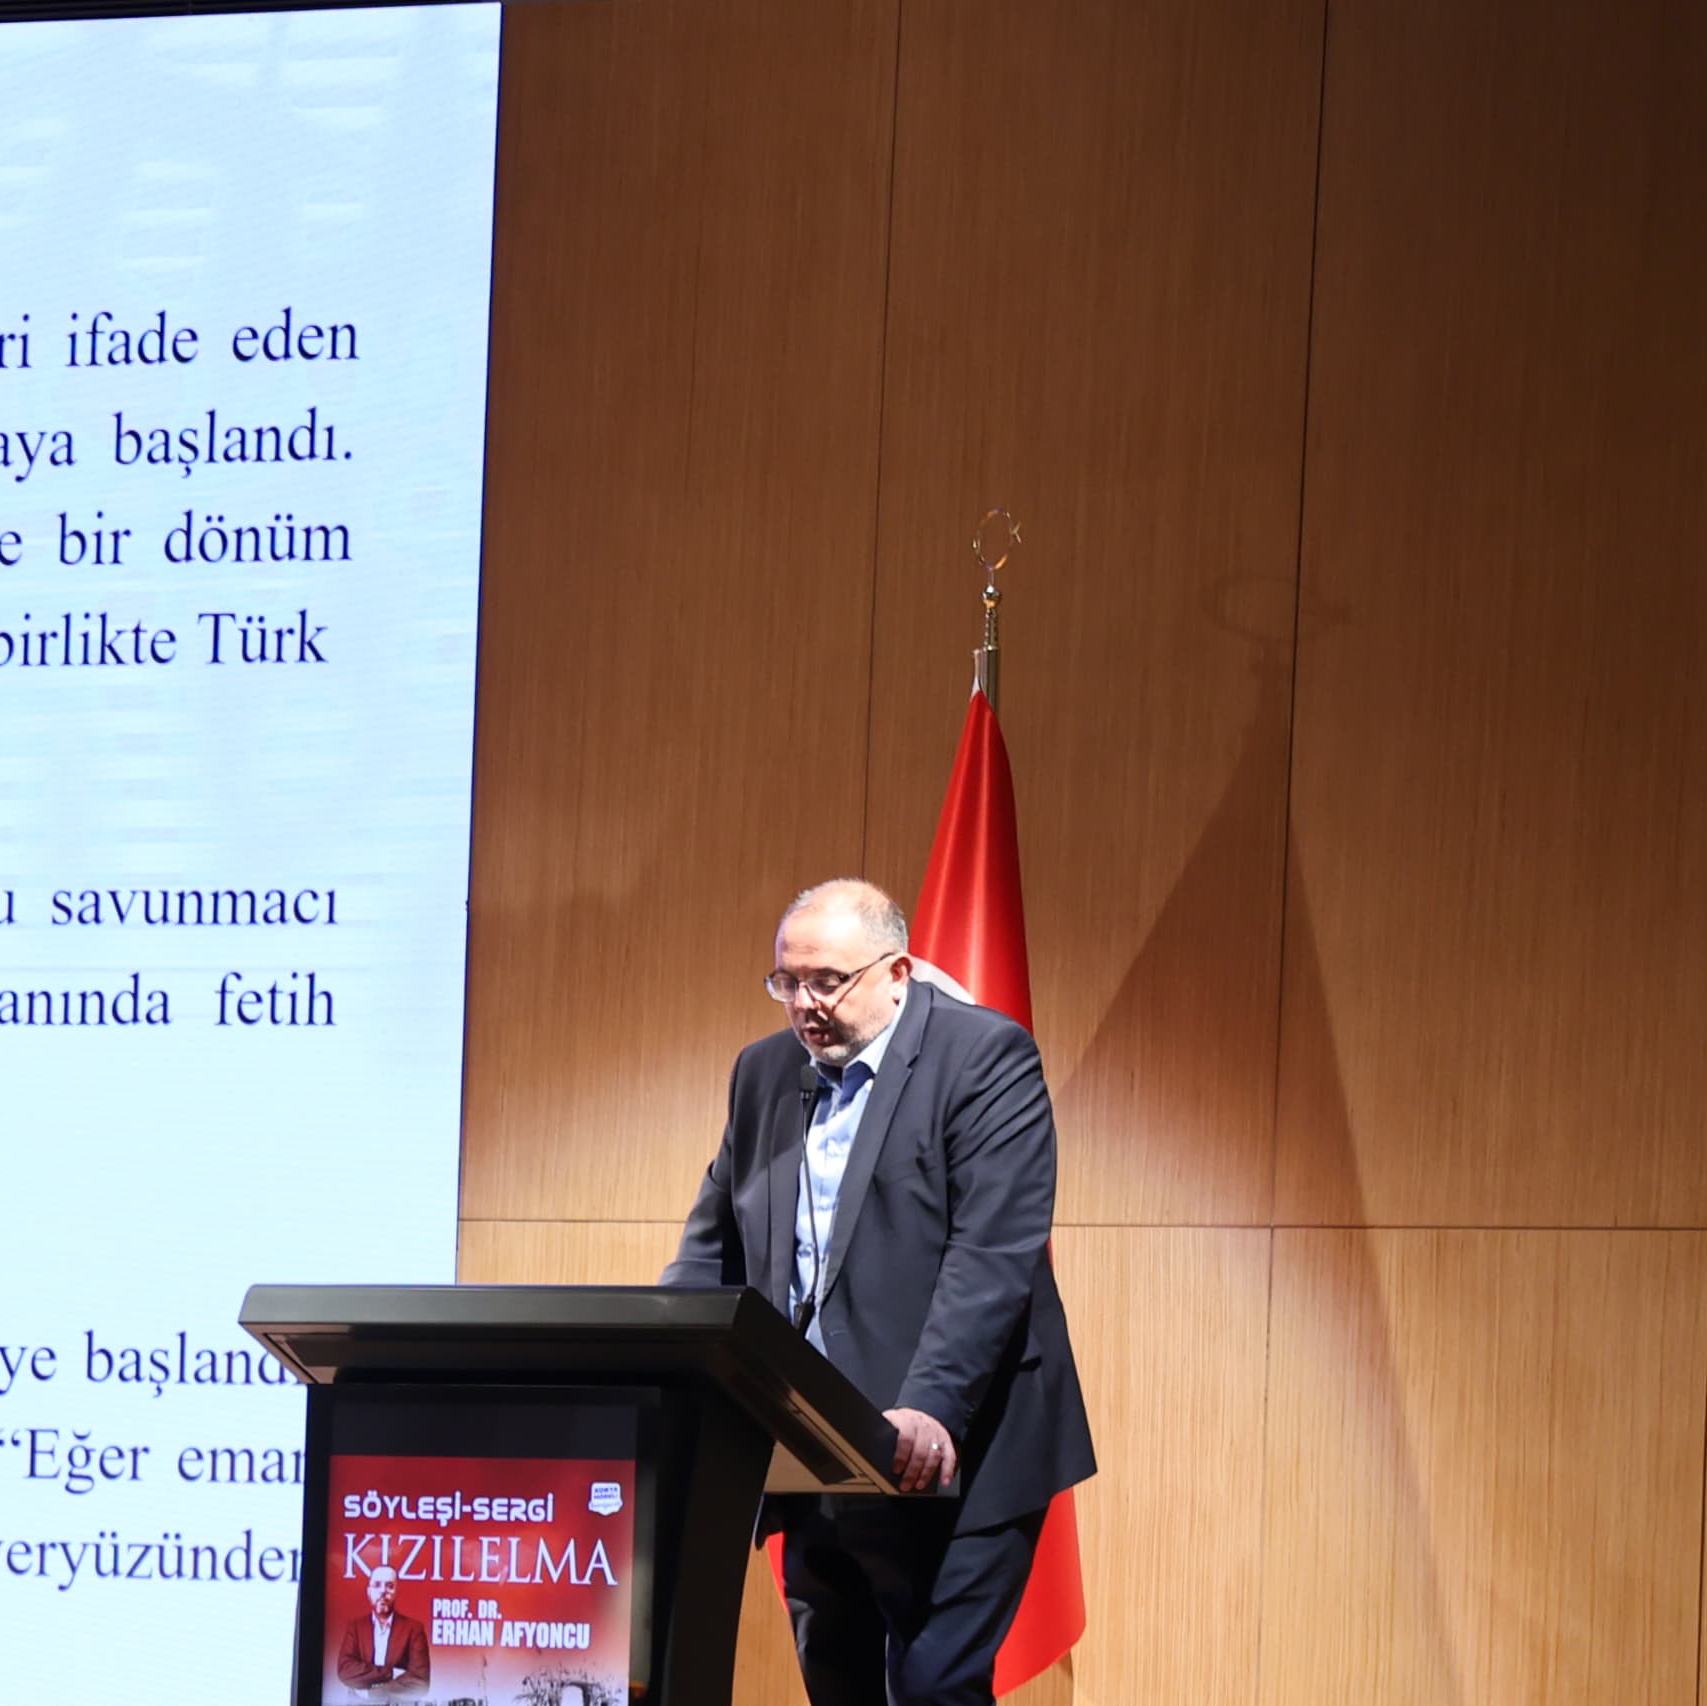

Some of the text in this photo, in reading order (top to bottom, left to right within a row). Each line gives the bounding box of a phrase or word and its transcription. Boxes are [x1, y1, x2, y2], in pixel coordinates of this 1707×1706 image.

[65, 308, 200, 369] ifade
[231, 304, 361, 364] eden
[112, 404, 353, 480] başlandı.
[57, 509, 133, 567] bir
[162, 508, 353, 565] dönüm
[196, 607, 329, 666] Türk
[50, 888, 338, 927] savunmacı
[215, 970, 336, 1027] fetih
[83, 1328, 304, 1399] başland
[343, 1489, 554, 1527] SÖYLEŞİ-SERGİ
[343, 1533, 619, 1586] KIZILELMA
[432, 1598, 503, 1620] PROF. DR.
[432, 1619, 591, 1650] ERHAN AFYONCU
